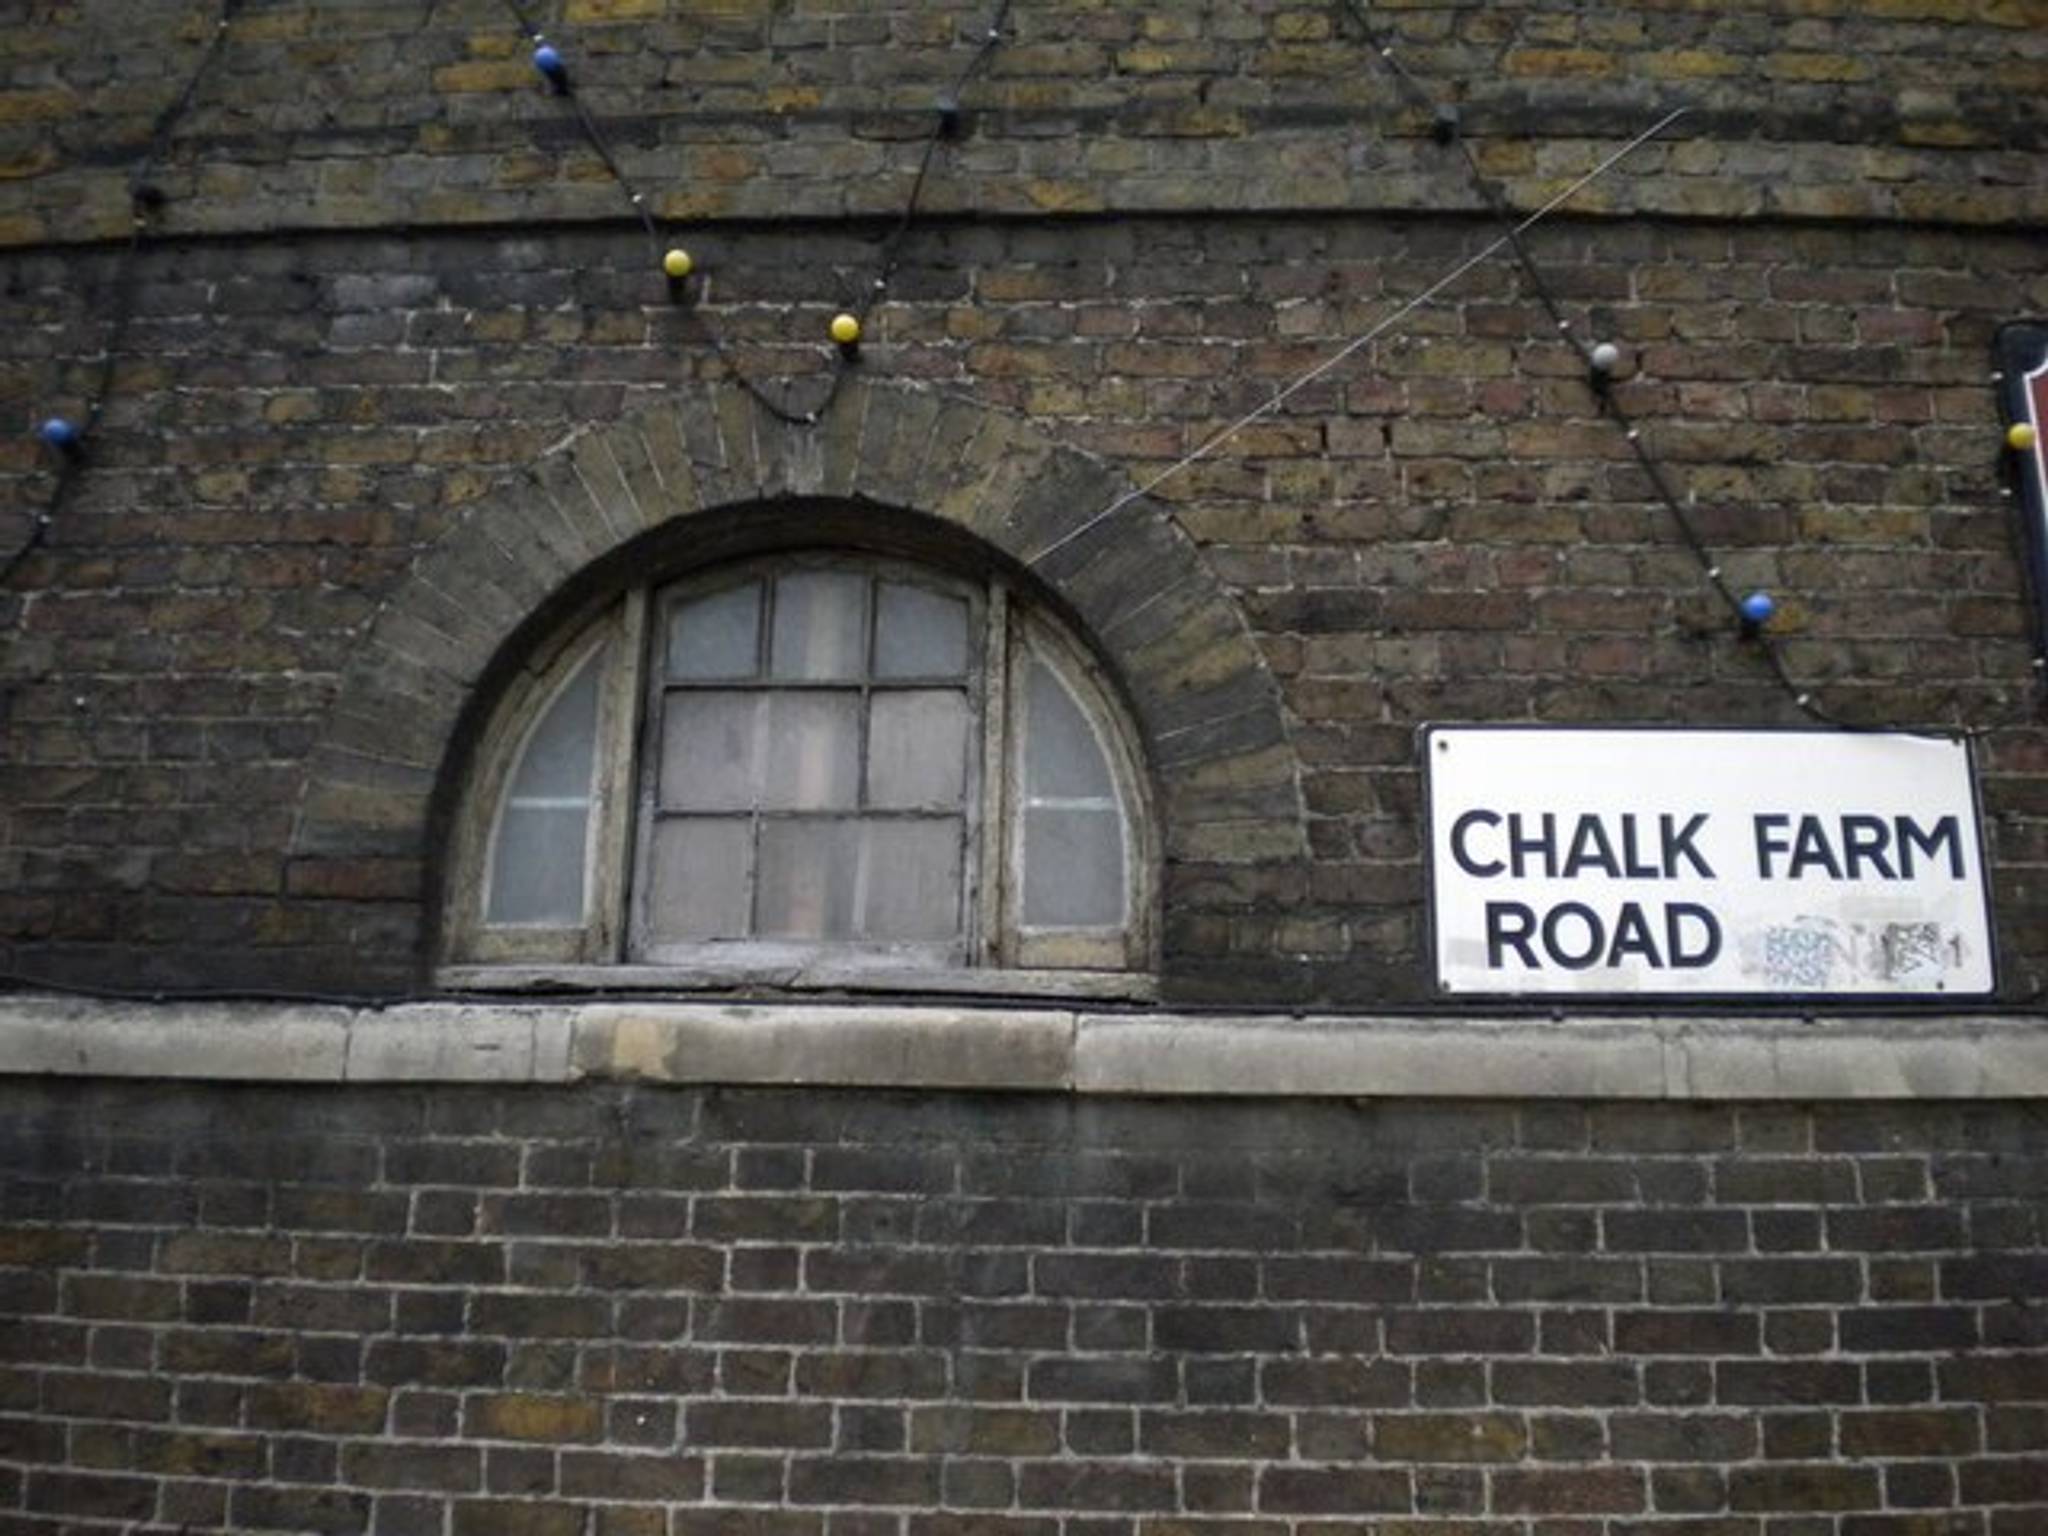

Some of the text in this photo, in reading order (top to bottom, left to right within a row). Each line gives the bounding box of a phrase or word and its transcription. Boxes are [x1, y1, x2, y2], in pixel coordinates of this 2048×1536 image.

[1450, 808, 1965, 880] CHALK FARM
[1486, 901, 1722, 970] ROAD
